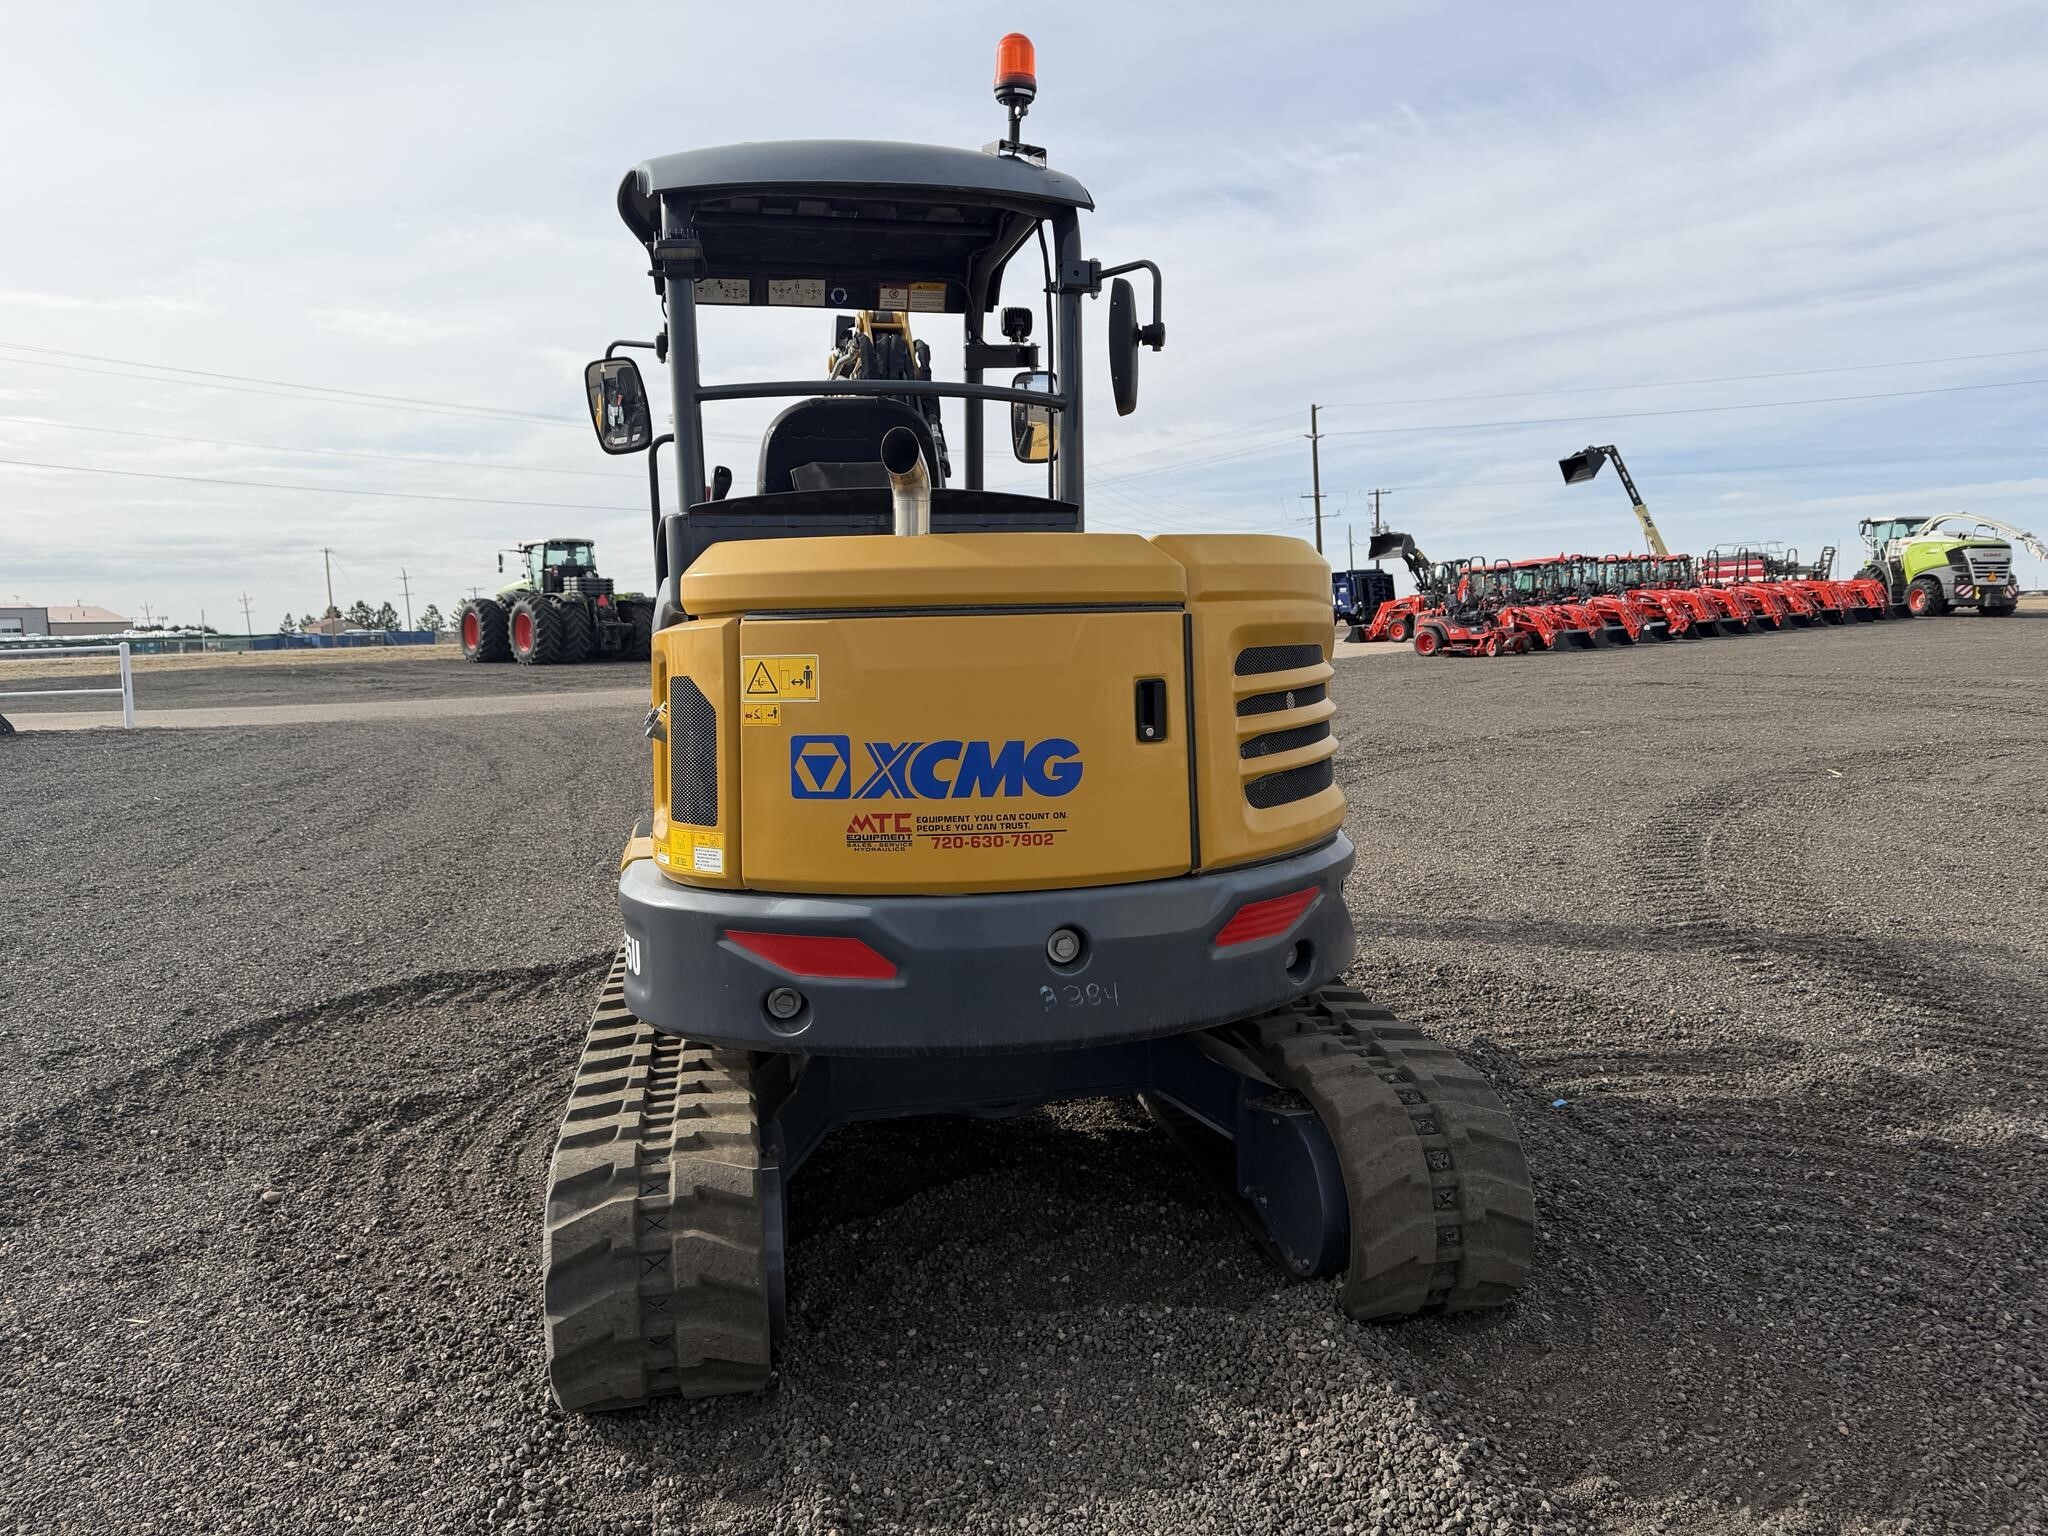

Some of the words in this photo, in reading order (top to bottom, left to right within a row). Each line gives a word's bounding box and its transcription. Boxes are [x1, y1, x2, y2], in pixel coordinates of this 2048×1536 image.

[851, 738, 1084, 800] XCMG
[846, 812, 913, 833] MTC
[916, 815, 970, 823] EQUIPMENT
[974, 814, 993, 822] YOU
[996, 813, 1016, 821] CAN
[1019, 812, 1050, 820] COUNT
[916, 824, 951, 832] PEOPLE
[955, 823, 974, 831] YOU
[976, 823, 997, 831] CAN
[846, 833, 913, 841] EQUIPMENT
[930, 833, 1054, 850] 720-630-7902
